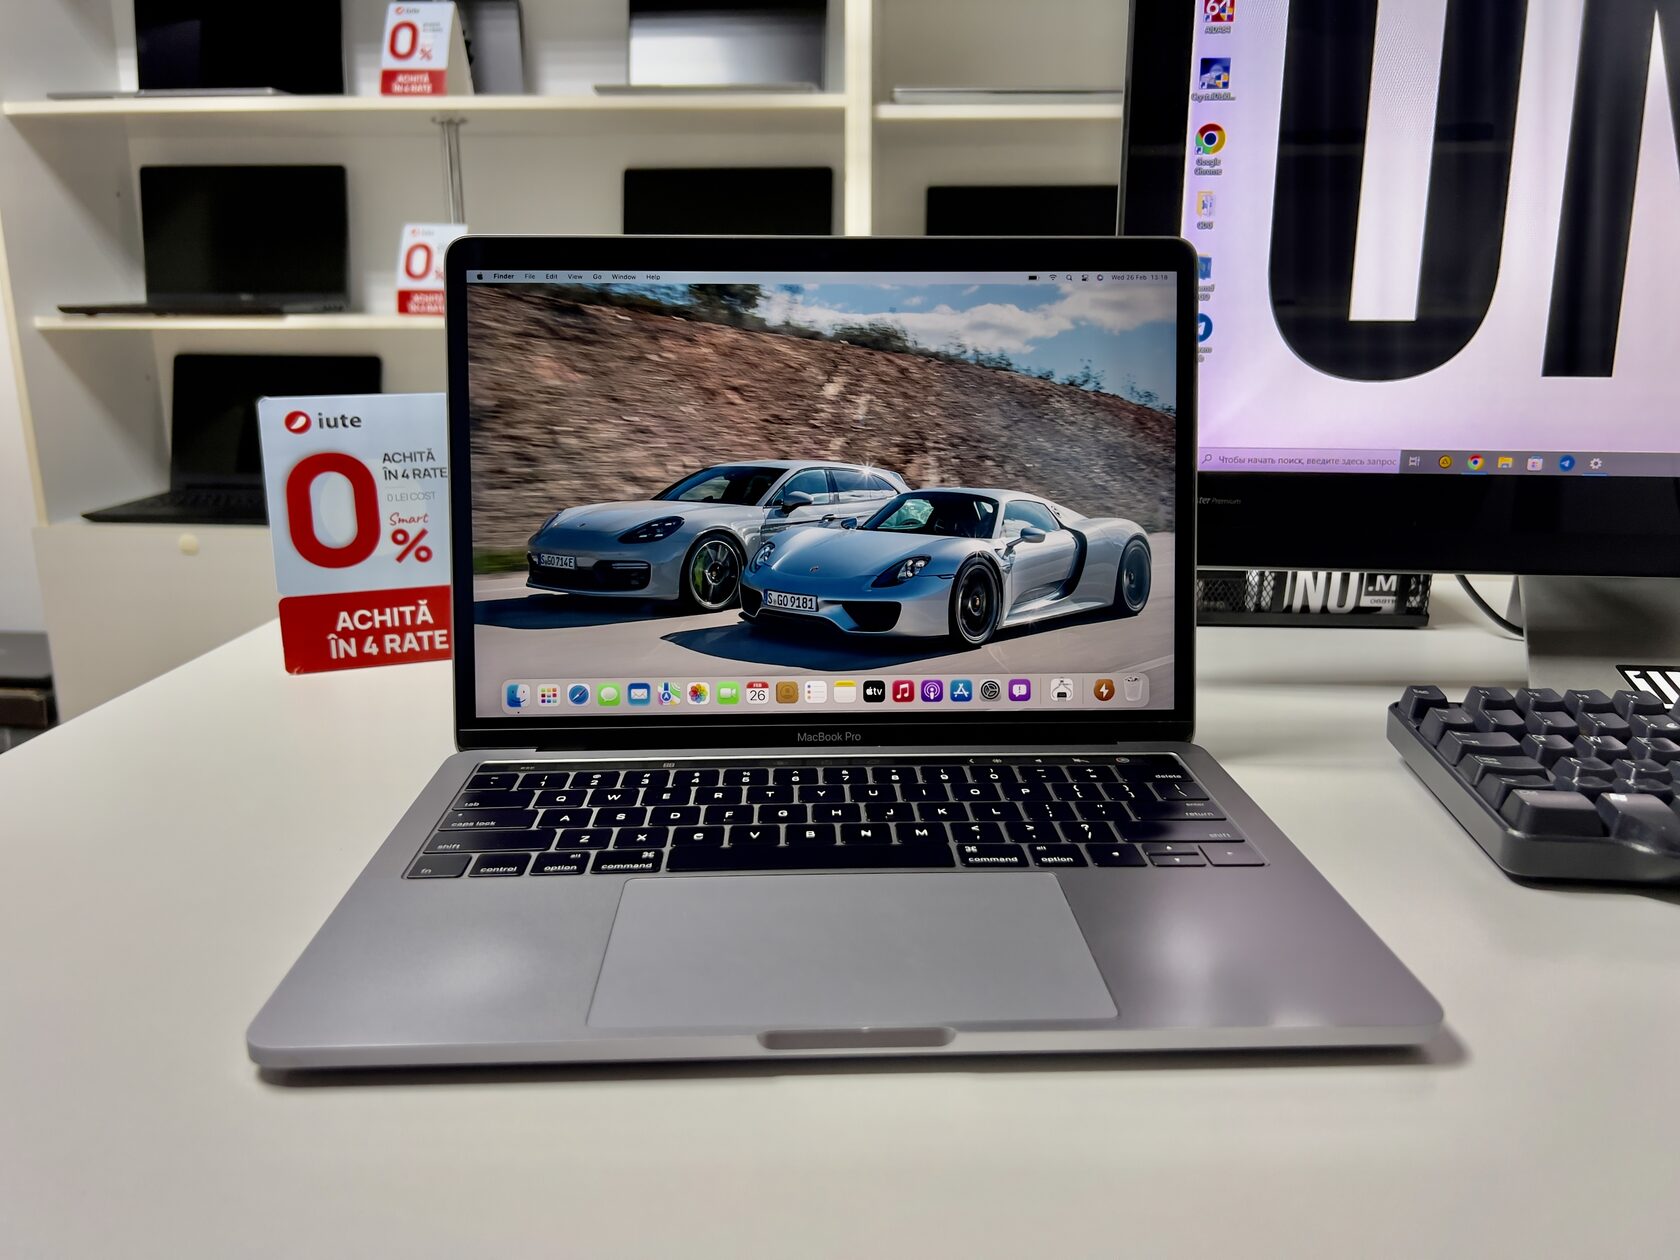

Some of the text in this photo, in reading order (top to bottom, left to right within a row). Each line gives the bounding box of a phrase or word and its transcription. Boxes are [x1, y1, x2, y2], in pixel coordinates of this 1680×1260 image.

[388, 20, 419, 61] 0
[1196, 158, 1221, 167] Google
[1194, 167, 1222, 175] Chrome
[404, 242, 433, 281] 0
[318, 412, 362, 430] iute
[382, 448, 436, 464] ACHITĂ
[1218, 455, 1246, 466] Чтобы
[1278, 457, 1304, 466] поиск,
[1307, 457, 1340, 466] введите
[1341, 459, 1365, 467] здесь
[1367, 459, 1396, 468] запрос
[382, 466, 448, 481] ÎN 4 RATE
[395, 493, 409, 502] LEI
[409, 491, 435, 501] COST
[285, 452, 433, 569] 0 %
[389, 511, 429, 526] Smart
[790, 596, 814, 610] 9181
[336, 599, 434, 632] ACHITĂ
[326, 629, 450, 659] ÎN 4 RATE
[750, 690, 766, 701] 26
[873, 687, 883, 695] tv
[797, 731, 861, 742] MacBook Pro
[693, 832, 704, 840] C
[750, 831, 760, 839] V
[806, 830, 816, 838] B
[915, 829, 928, 837] M
[579, 835, 590, 843] Z
[544, 864, 577, 873] option
[601, 862, 652, 870] command
